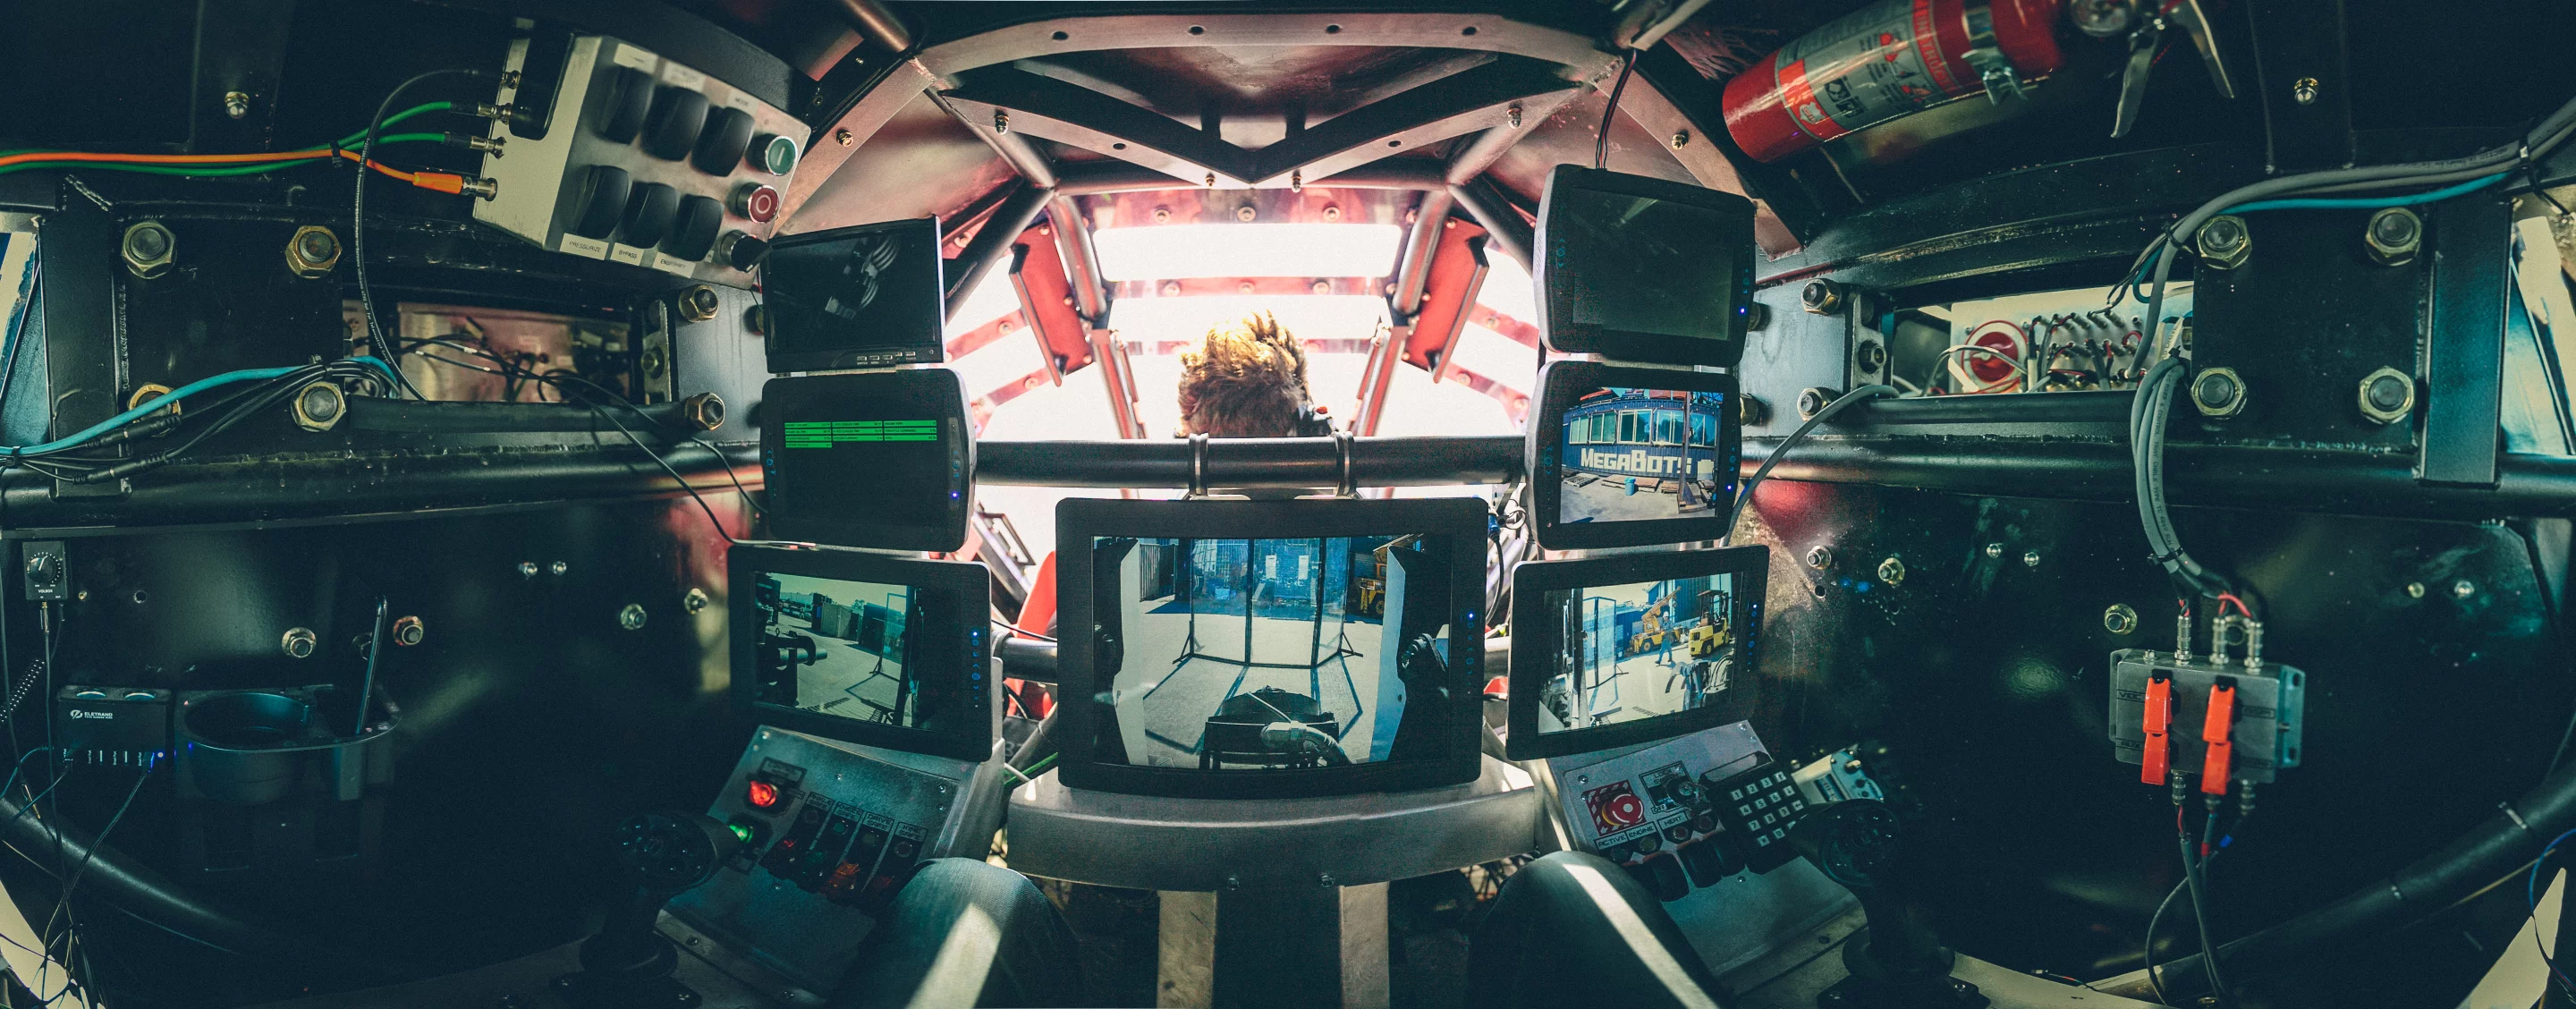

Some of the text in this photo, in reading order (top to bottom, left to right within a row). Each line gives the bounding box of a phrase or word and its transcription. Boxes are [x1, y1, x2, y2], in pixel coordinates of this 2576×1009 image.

[569, 242, 602, 253] PRESSURIZE
[619, 250, 637, 259] BYPASS
[2121, 741, 2140, 749] AUX
[838, 802, 862, 815] KNEES
[868, 814, 891, 825] DRIVE
[1664, 816, 1682, 825] HEAT
[867, 820, 888, 830] SAFE
[903, 824, 921, 832] KINE
[899, 830, 921, 840] SAFE
[1628, 825, 1654, 838] ENGINE
[1598, 835, 1626, 848] ACTIVE
